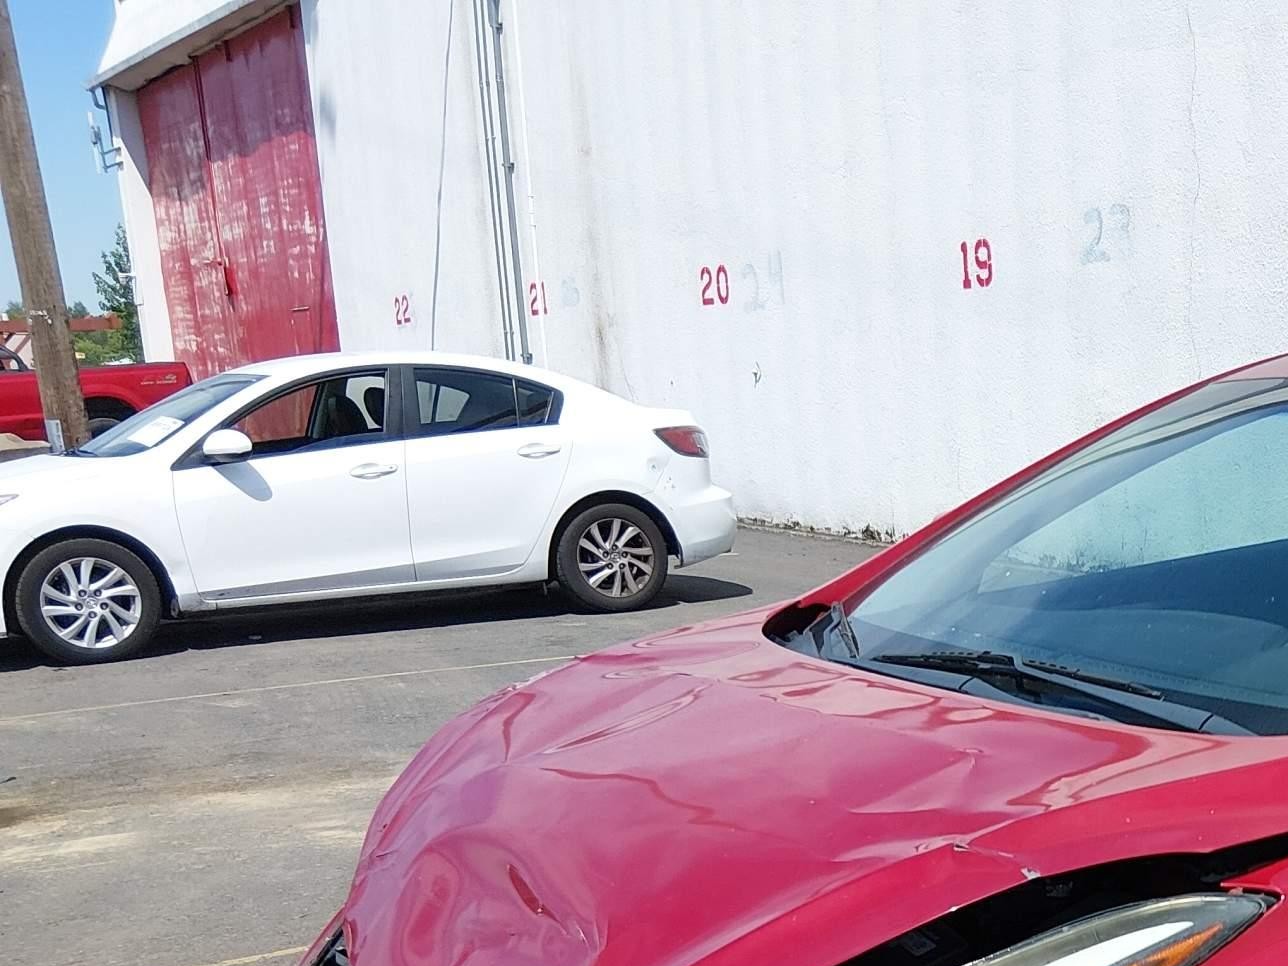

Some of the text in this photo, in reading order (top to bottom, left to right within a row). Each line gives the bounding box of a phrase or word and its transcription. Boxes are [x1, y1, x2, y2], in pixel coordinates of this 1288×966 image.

[960, 239, 994, 290] 19
[529, 281, 548, 316] 21
[700, 264, 729, 306] 20
[394, 295, 411, 325] 22
